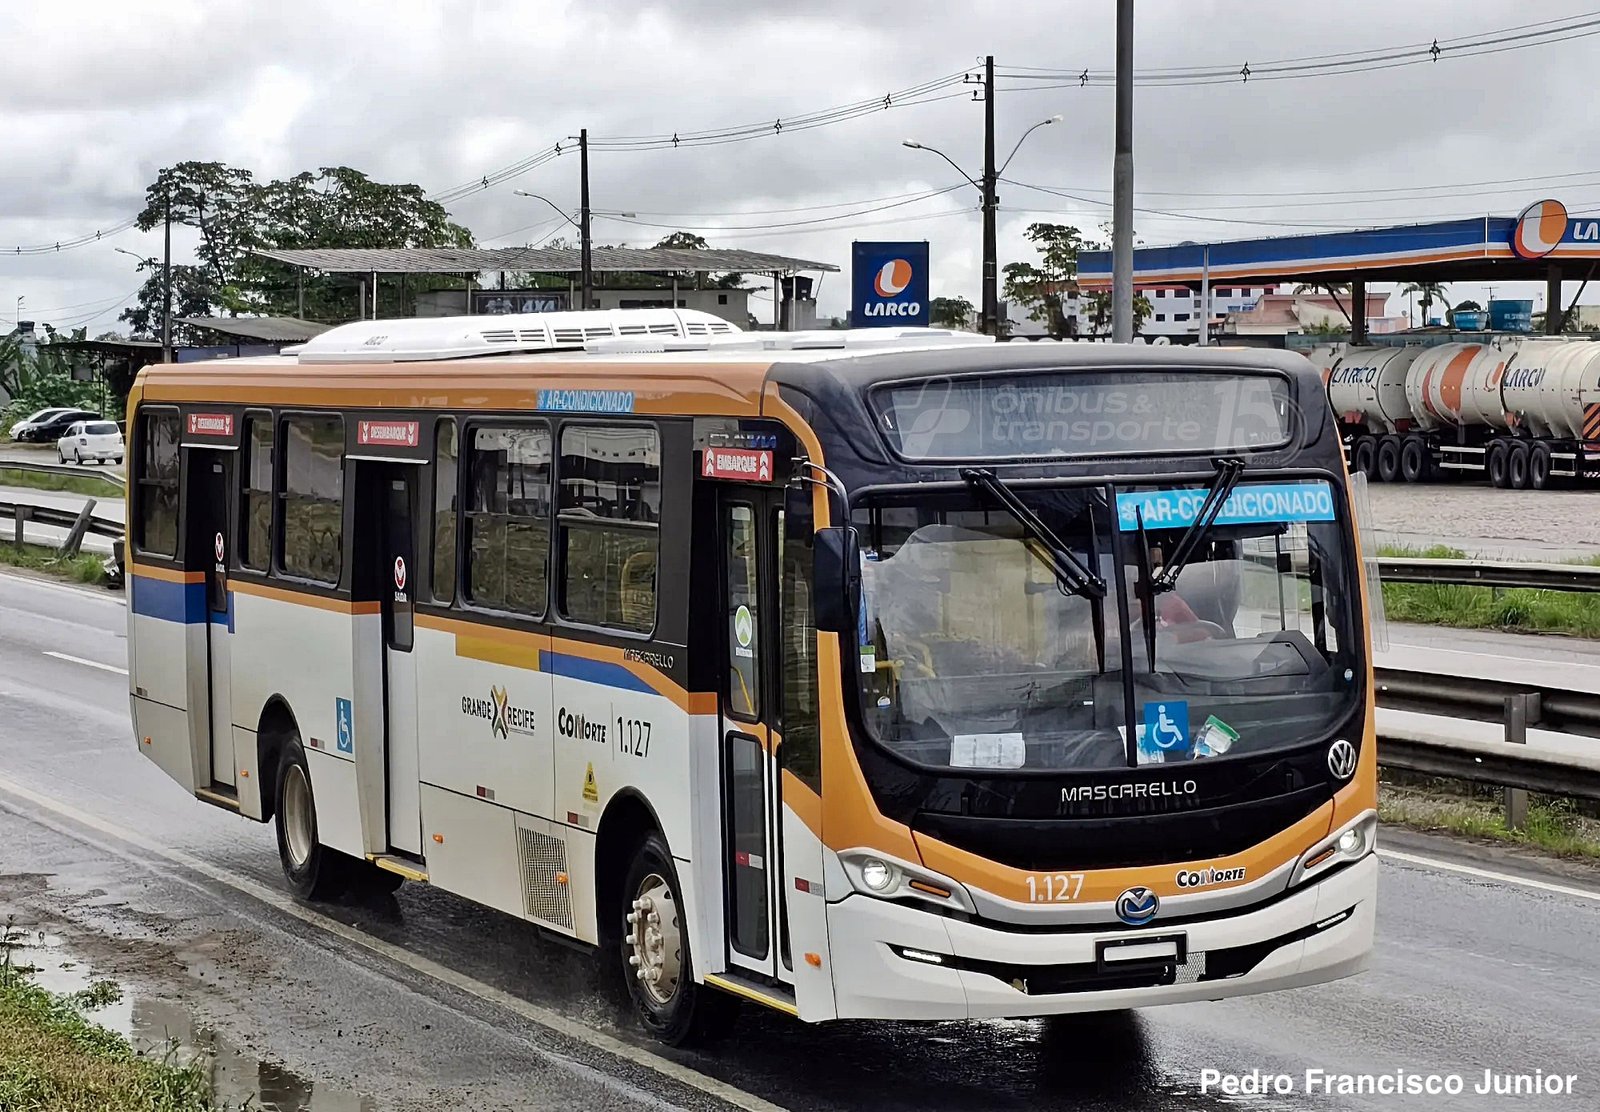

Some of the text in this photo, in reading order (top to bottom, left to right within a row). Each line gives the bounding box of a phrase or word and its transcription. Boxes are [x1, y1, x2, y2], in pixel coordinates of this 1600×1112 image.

[864, 302, 921, 317] LARCO
[1332, 367, 1377, 384] LARCO
[547, 390, 634, 413] AR-CONDICIONADO
[716, 453, 757, 473] EMBARQUE
[623, 648, 674, 669] MASCARELLO
[461, 696, 535, 730] GRANDE RECIFE
[617, 716, 652, 758] 1.127
[1061, 779, 1198, 802] MASCARELLO
[1025, 873, 1085, 902] 1.127
